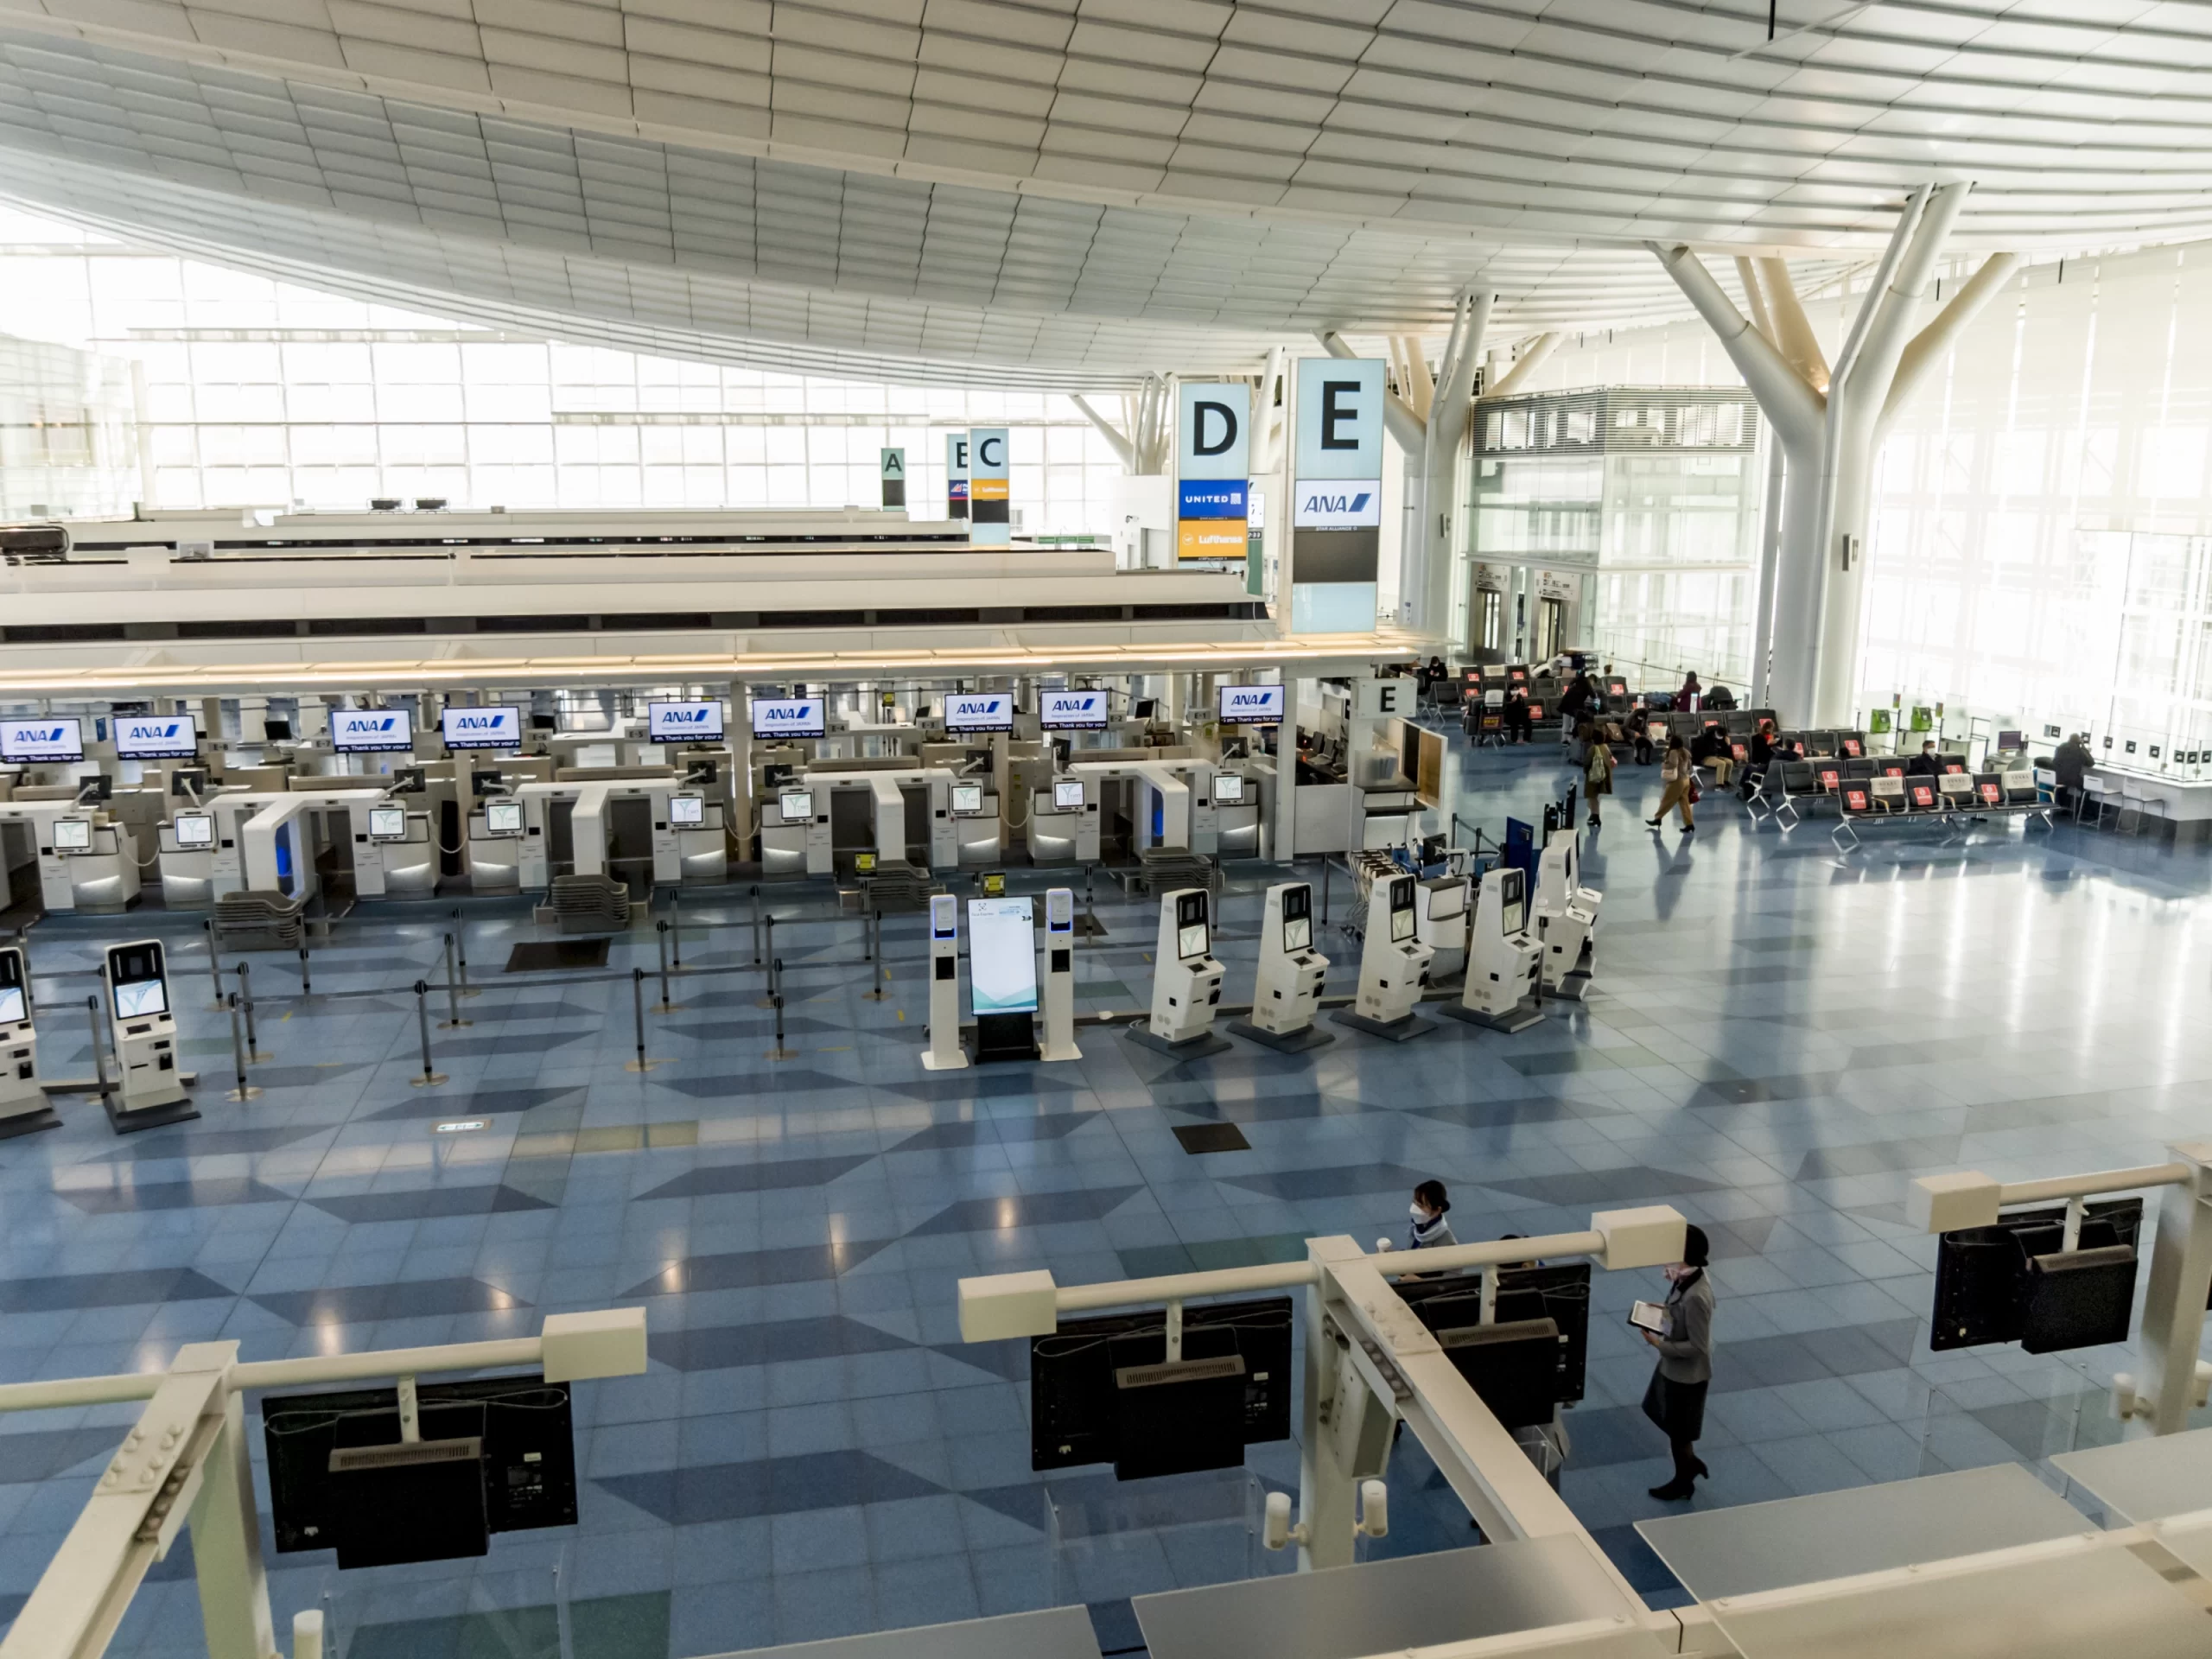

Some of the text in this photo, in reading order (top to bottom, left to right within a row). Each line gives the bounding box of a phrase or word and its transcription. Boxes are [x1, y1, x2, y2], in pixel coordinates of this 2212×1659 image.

[1321, 381, 1361, 450] E
[1193, 401, 1237, 455] D
[980, 438, 1001, 467] C
[885, 454, 902, 472] A
[1303, 495, 1346, 512] ANA
[1198, 535, 1243, 544] Lufthansa
[1230, 695, 1258, 705] ANA
[1380, 686, 1396, 712] E
[957, 703, 985, 714] ANA
[1052, 700, 1080, 711] ANA
[662, 711, 693, 722] ANA
[765, 709, 795, 720] ANA
[346, 721, 378, 732] ANA
[456, 717, 488, 729] ANA
[14, 730, 48, 742] ANA
[130, 727, 162, 738] ANA
